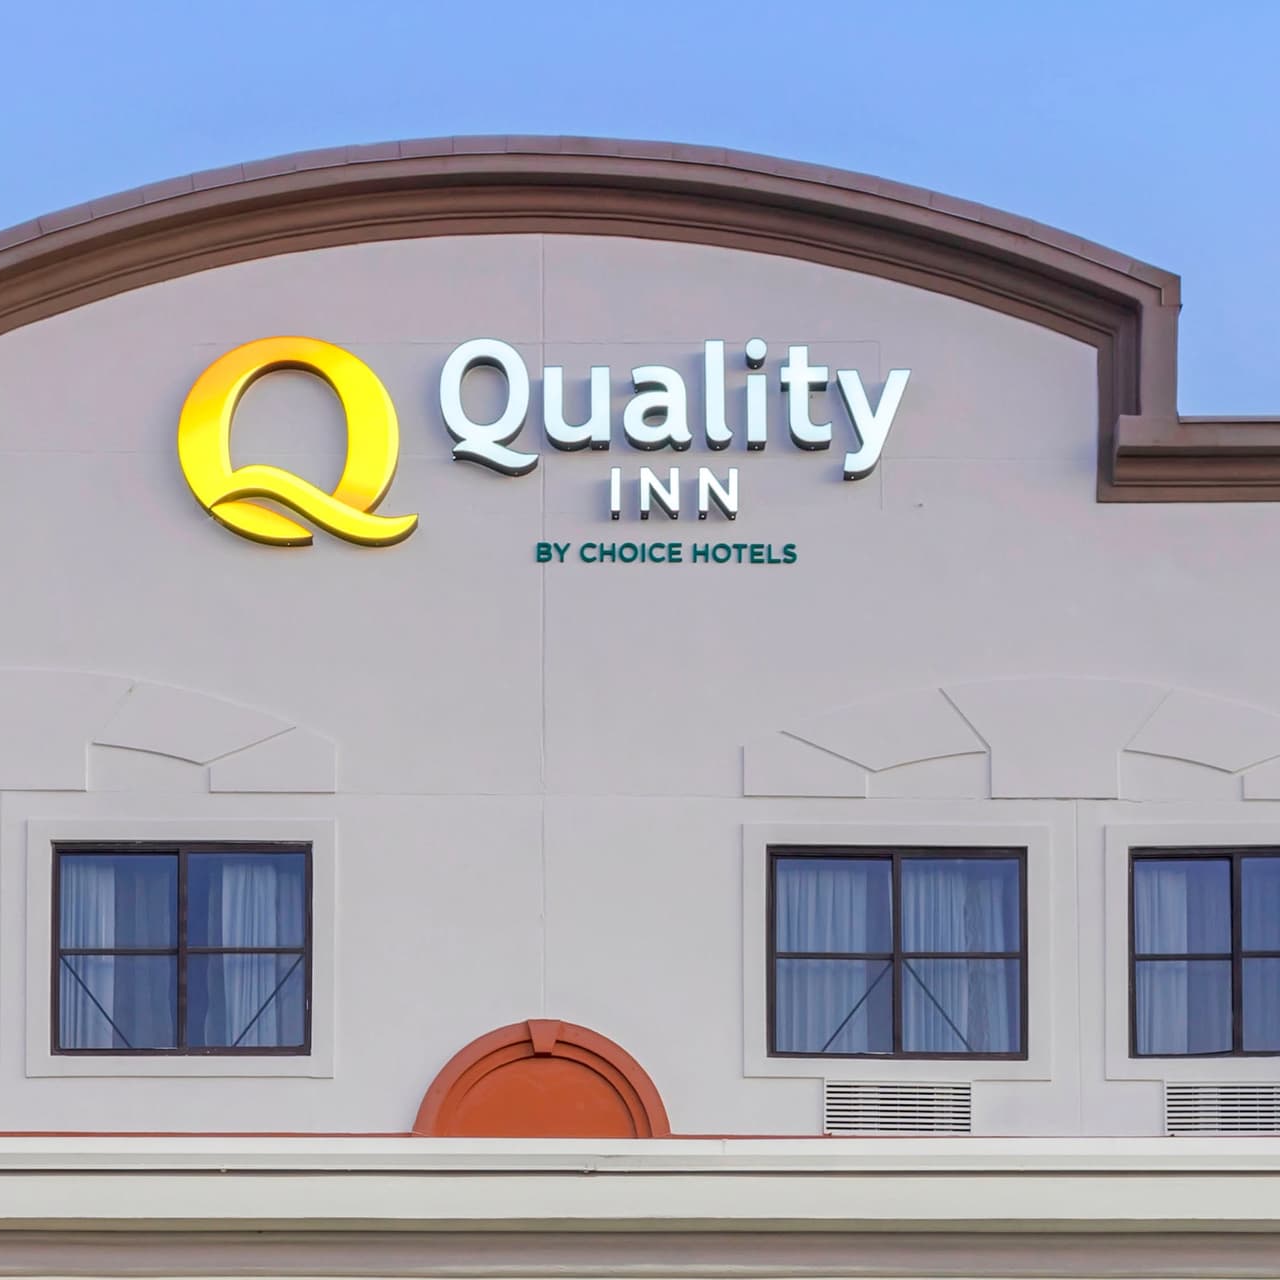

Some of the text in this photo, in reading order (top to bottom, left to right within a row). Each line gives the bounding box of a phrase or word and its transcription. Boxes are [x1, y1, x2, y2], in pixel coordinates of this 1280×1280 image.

[177, 335, 418, 547] Q
[439, 337, 912, 481] Quality
[610, 466, 738, 520] INN
[536, 542, 798, 564] BY CHOICE HOTELS
